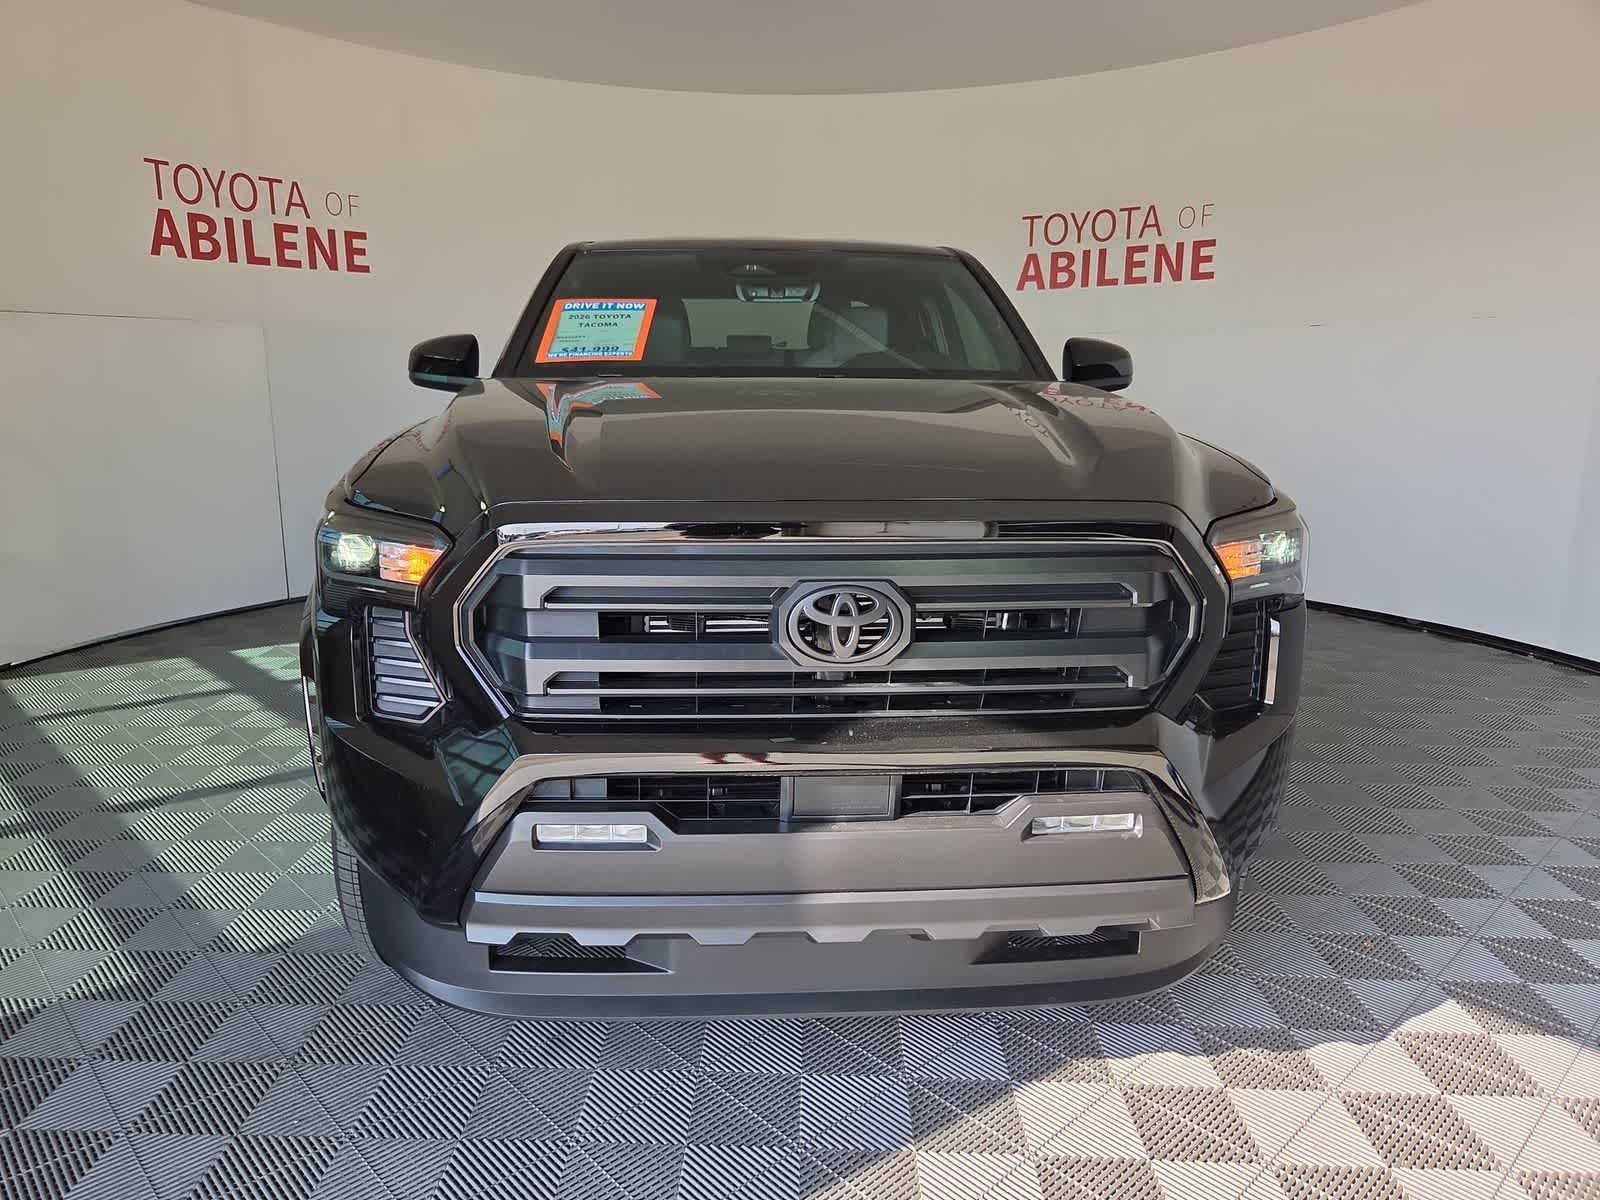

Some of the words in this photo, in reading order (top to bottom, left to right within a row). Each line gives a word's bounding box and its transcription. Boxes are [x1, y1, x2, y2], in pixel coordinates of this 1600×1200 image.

[143, 157, 311, 219] TOYOTA
[325, 191, 359, 217] OF
[150, 208, 370, 274] ABILENE
[1022, 205, 1162, 247] TOYOTA
[1178, 203, 1215, 229] OF
[1016, 239, 1217, 291] ABILENE
